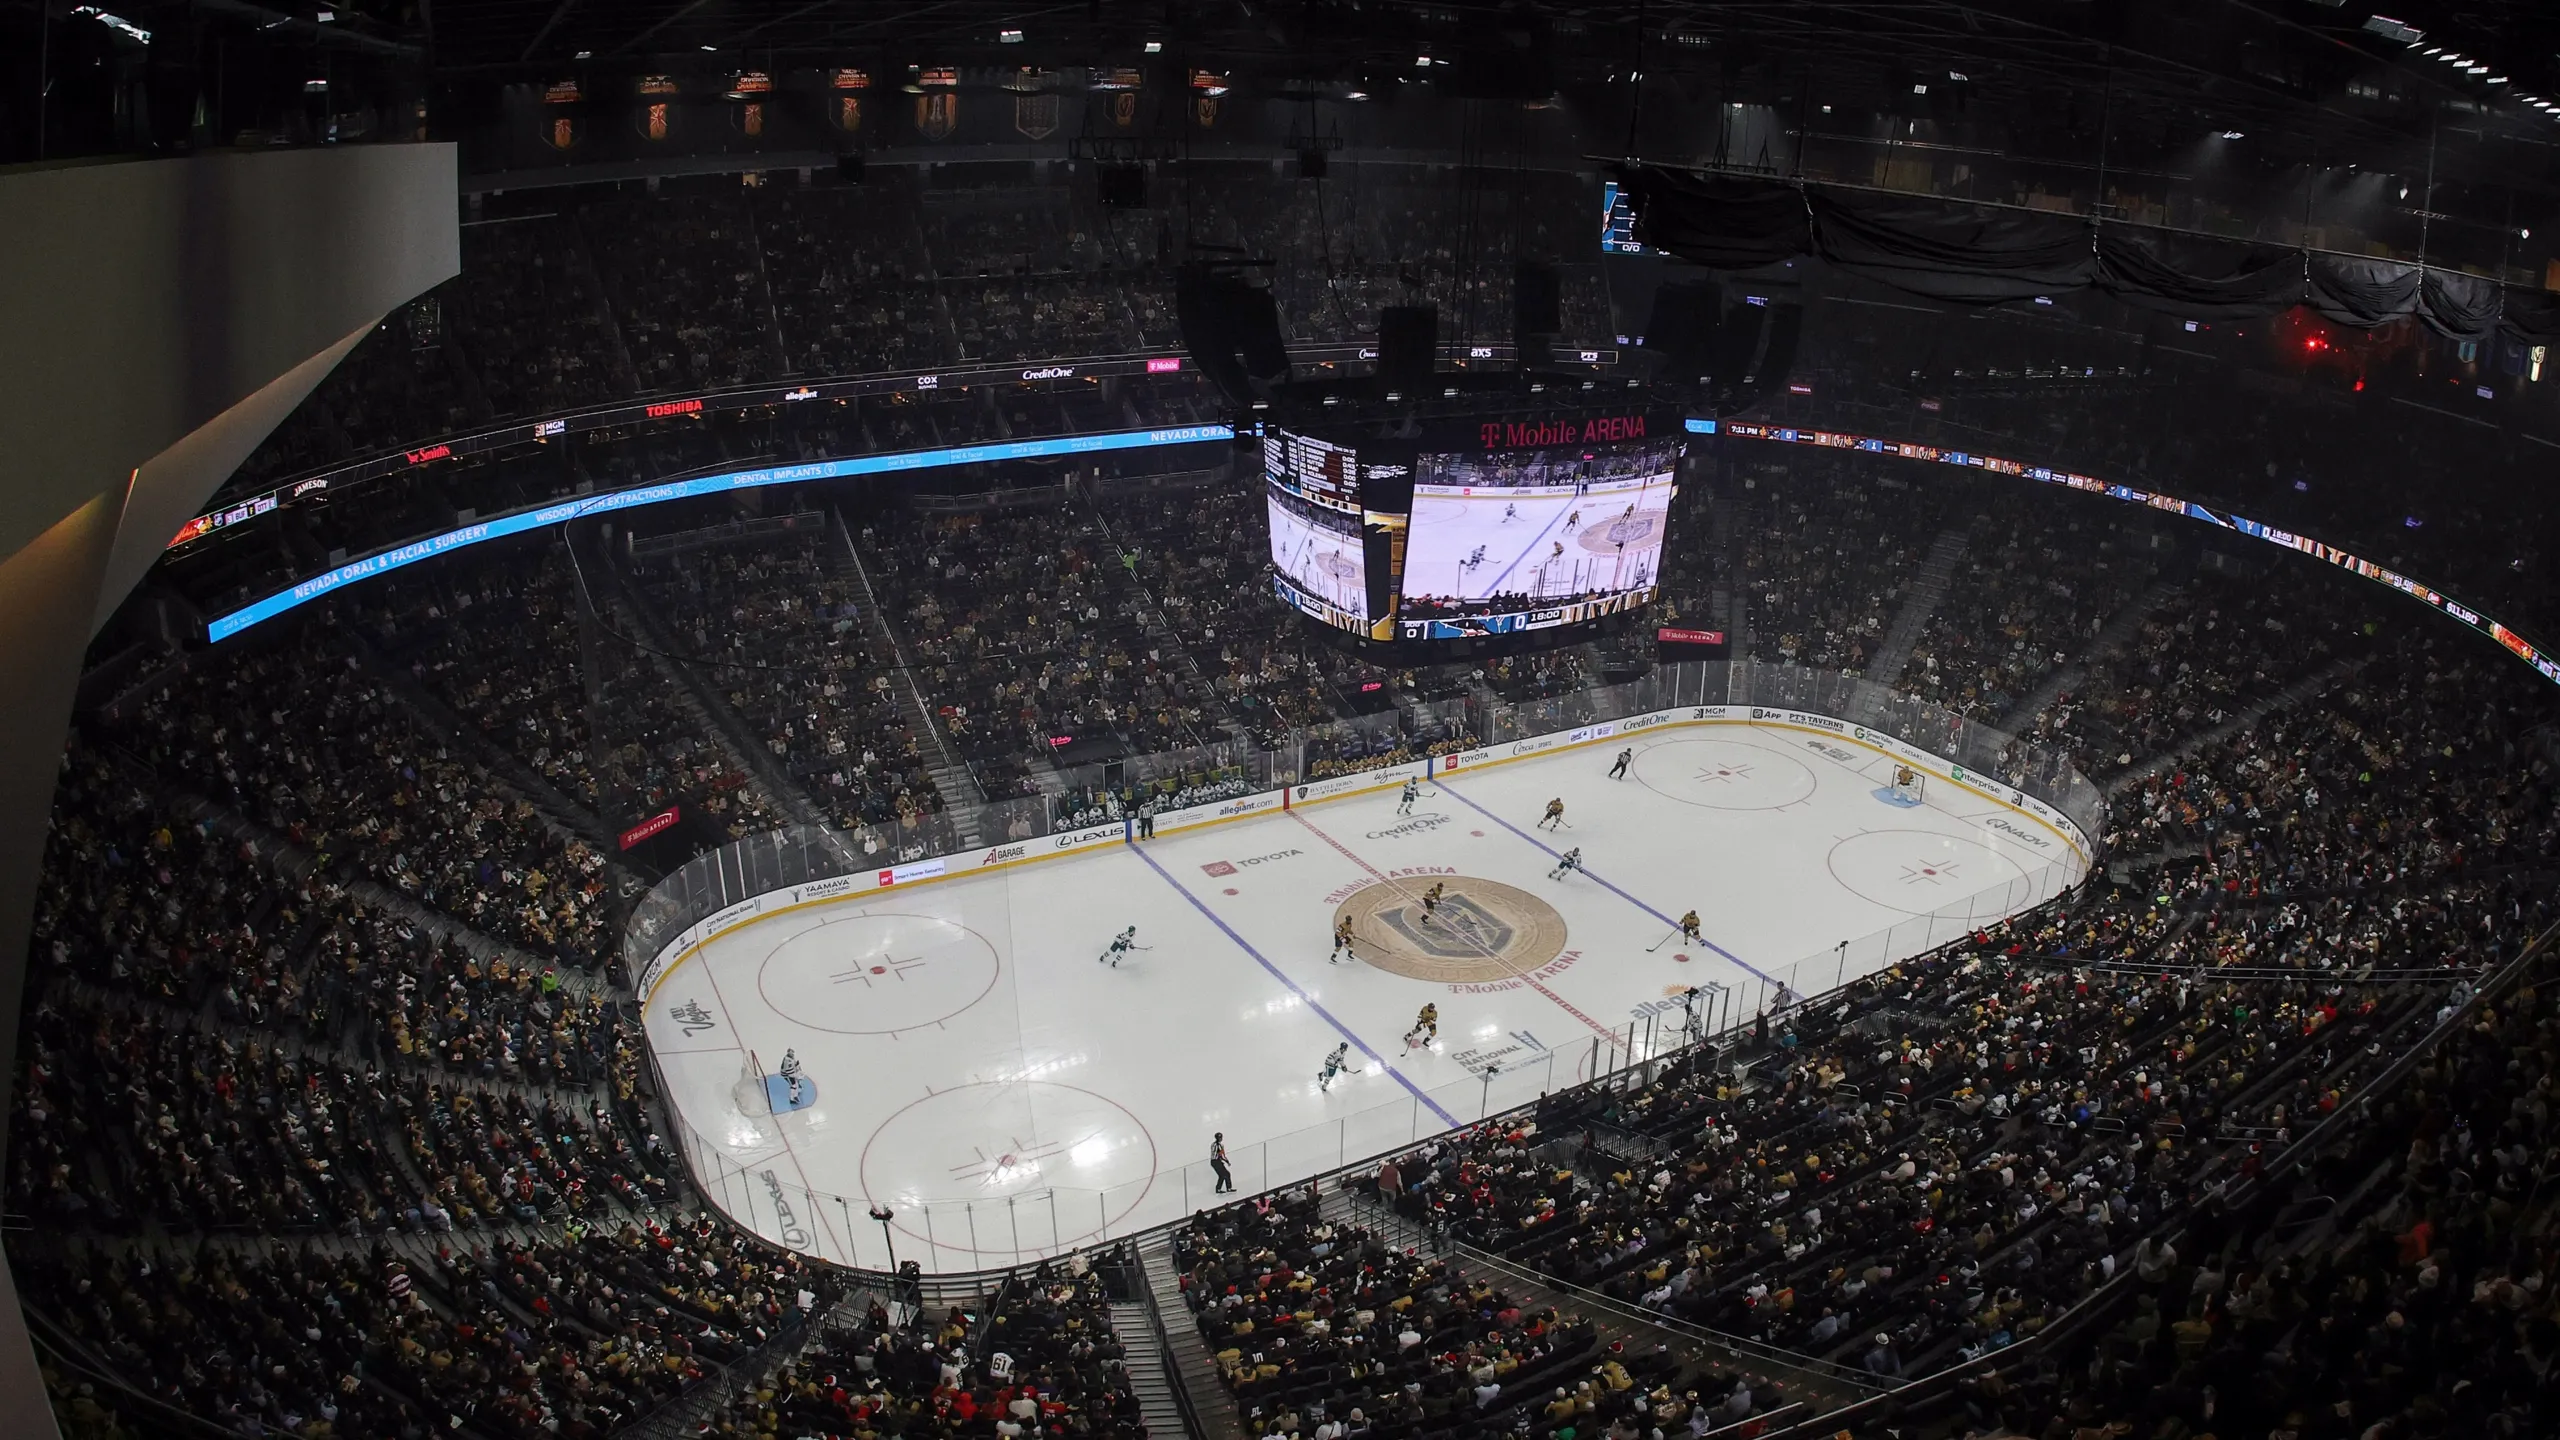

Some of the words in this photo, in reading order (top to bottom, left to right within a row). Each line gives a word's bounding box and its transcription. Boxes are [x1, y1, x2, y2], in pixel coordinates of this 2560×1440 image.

[1471, 347, 1491, 358] axs
[918, 376, 937, 385] COX
[1023, 367, 1074, 380] CreditOne
[785, 390, 817, 400] allegiant
[646, 400, 703, 417] TOSHIBA
[546, 420, 564, 431] MGM
[1506, 420, 1576, 447] Mobile
[1583, 415, 1645, 441] ARENA
[1731, 425, 1745, 435] 7:11
[1747, 427, 1757, 435] PM
[1150, 429, 1197, 442] NEVADA
[1201, 426, 1231, 438] ORAL
[734, 470, 772, 485] DENTAL
[774, 466, 822, 480] IMPLANTS
[294, 480, 328, 497] JAMESON
[536, 505, 575, 523] WISDOM
[608, 487, 673, 506] EXTRACTIONS
[2262, 527, 2270, 538] 0
[294, 572, 340, 600] NEVADA
[343, 560, 376, 580] ORAL
[379, 556, 388, 568] &
[391, 540, 432, 563] FACIAL
[435, 524, 490, 549] SURGERY
[1515, 615, 1526, 630] 0
[1531, 610, 1560, 622] 18:00
[1563, 608, 1571, 622] 1
[1407, 628, 1417, 638] 0
[1624, 713, 1670, 731] CreditOne
[1808, 716, 1844, 729] TAVERNS
[1461, 752, 1489, 764] TOYOTA
[1900, 747, 1923, 761] CAESARS
[1219, 798, 1273, 815] allegiant.com
[1074, 826, 1124, 843] LEXUS
[1366, 814, 1451, 840] CreditOne
[998, 846, 1025, 859] GARAGE
[1237, 848, 1304, 868] TOYOTA
[1389, 866, 1457, 878] ARENA
[1465, 981, 1523, 994] Mobile
[1535, 950, 1583, 982] ARENA
[1452, 1048, 1479, 1061] CITY
[1459, 1045, 1523, 1067] NATIONAL
[760, 1169, 797, 1231] LEXUS
[993, 1357, 1006, 1371] 61
